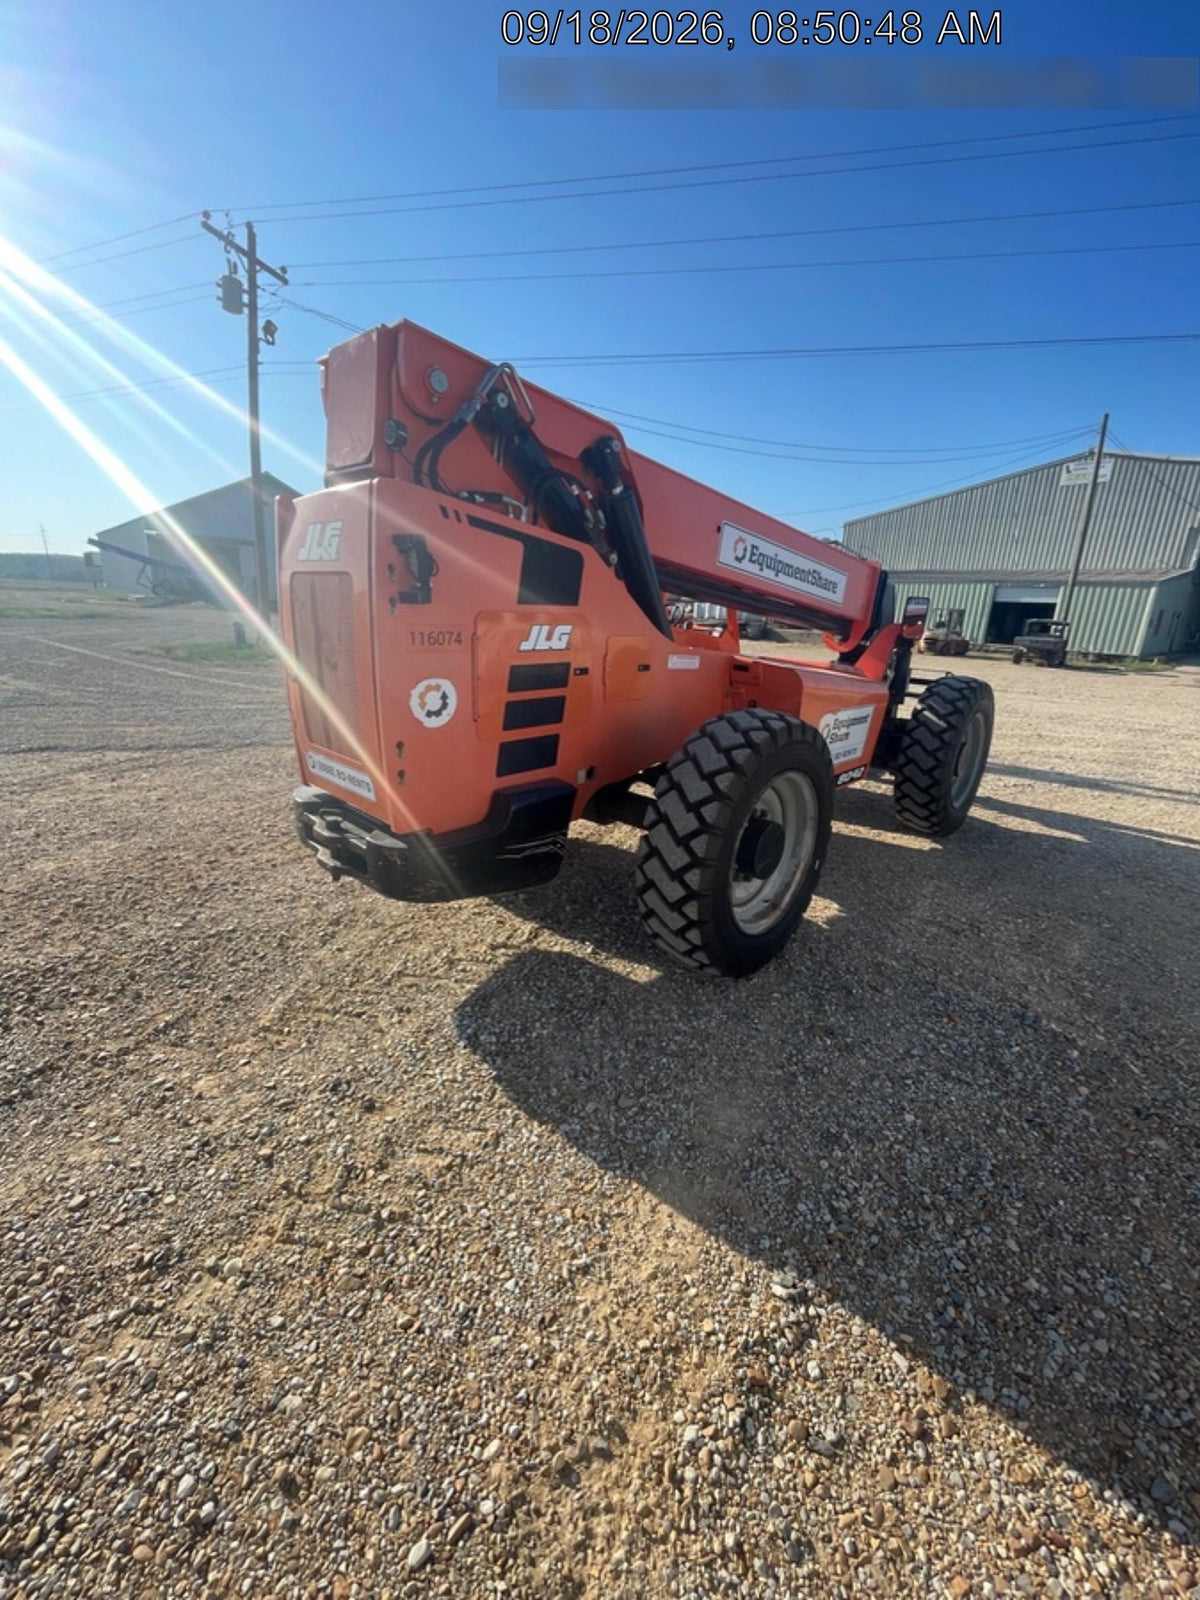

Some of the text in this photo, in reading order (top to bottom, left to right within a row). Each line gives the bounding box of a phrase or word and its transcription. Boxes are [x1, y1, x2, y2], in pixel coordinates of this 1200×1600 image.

[297, 521, 342, 562] JLG
[748, 544, 838, 594] EquipmentShare
[409, 631, 463, 646] 116074
[518, 624, 573, 651] JLG
